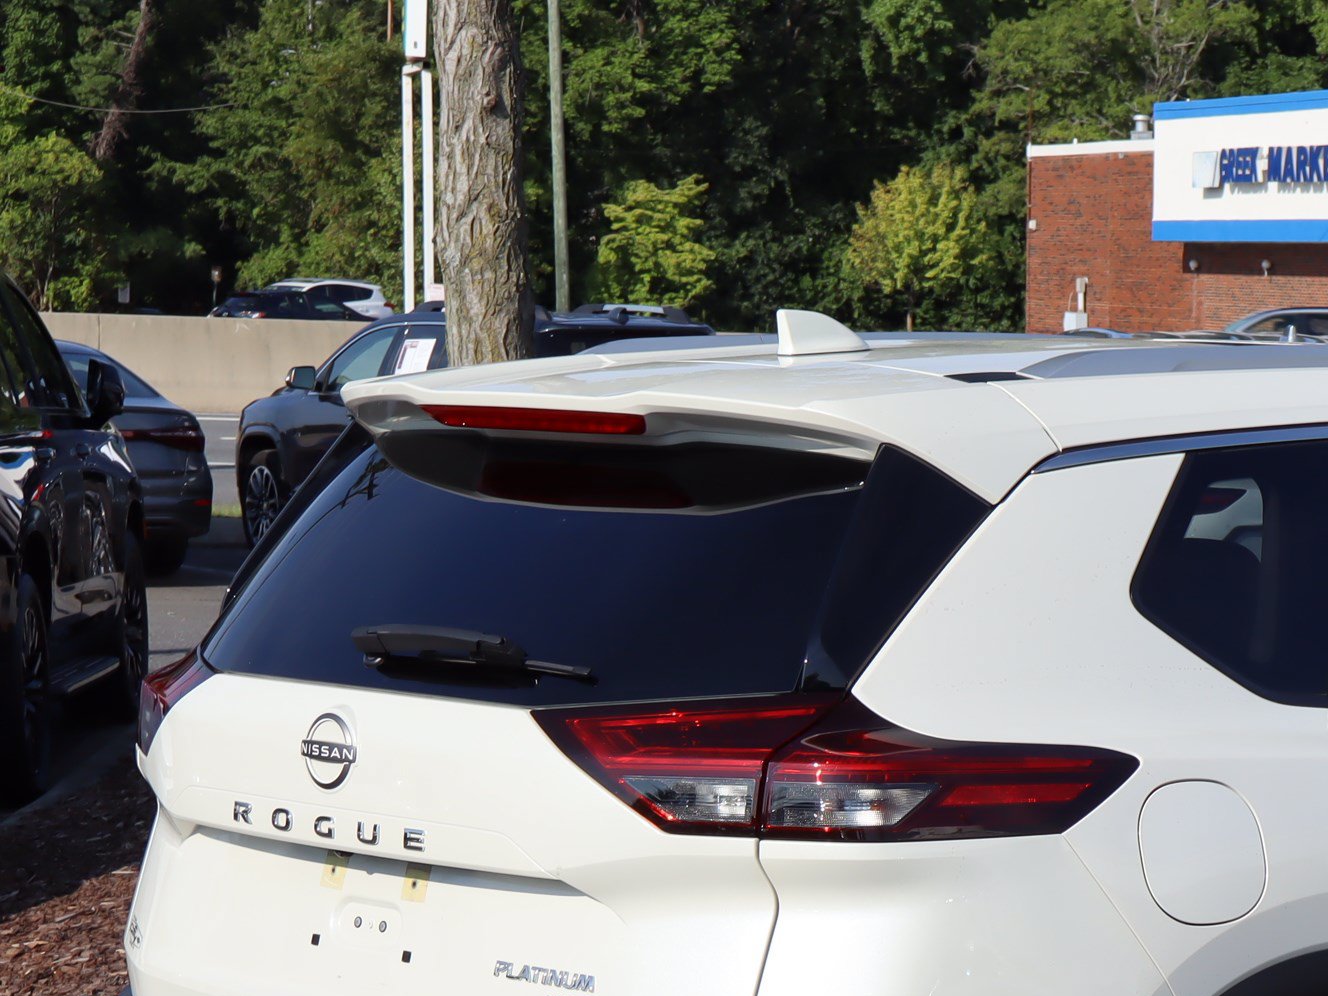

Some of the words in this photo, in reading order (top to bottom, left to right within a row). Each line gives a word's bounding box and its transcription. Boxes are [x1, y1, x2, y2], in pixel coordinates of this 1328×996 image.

[1219, 147, 1260, 183] GREEK
[301, 742, 354, 760] NISSAN
[233, 800, 428, 852] ROGUE
[493, 960, 596, 993] PLATINUM
